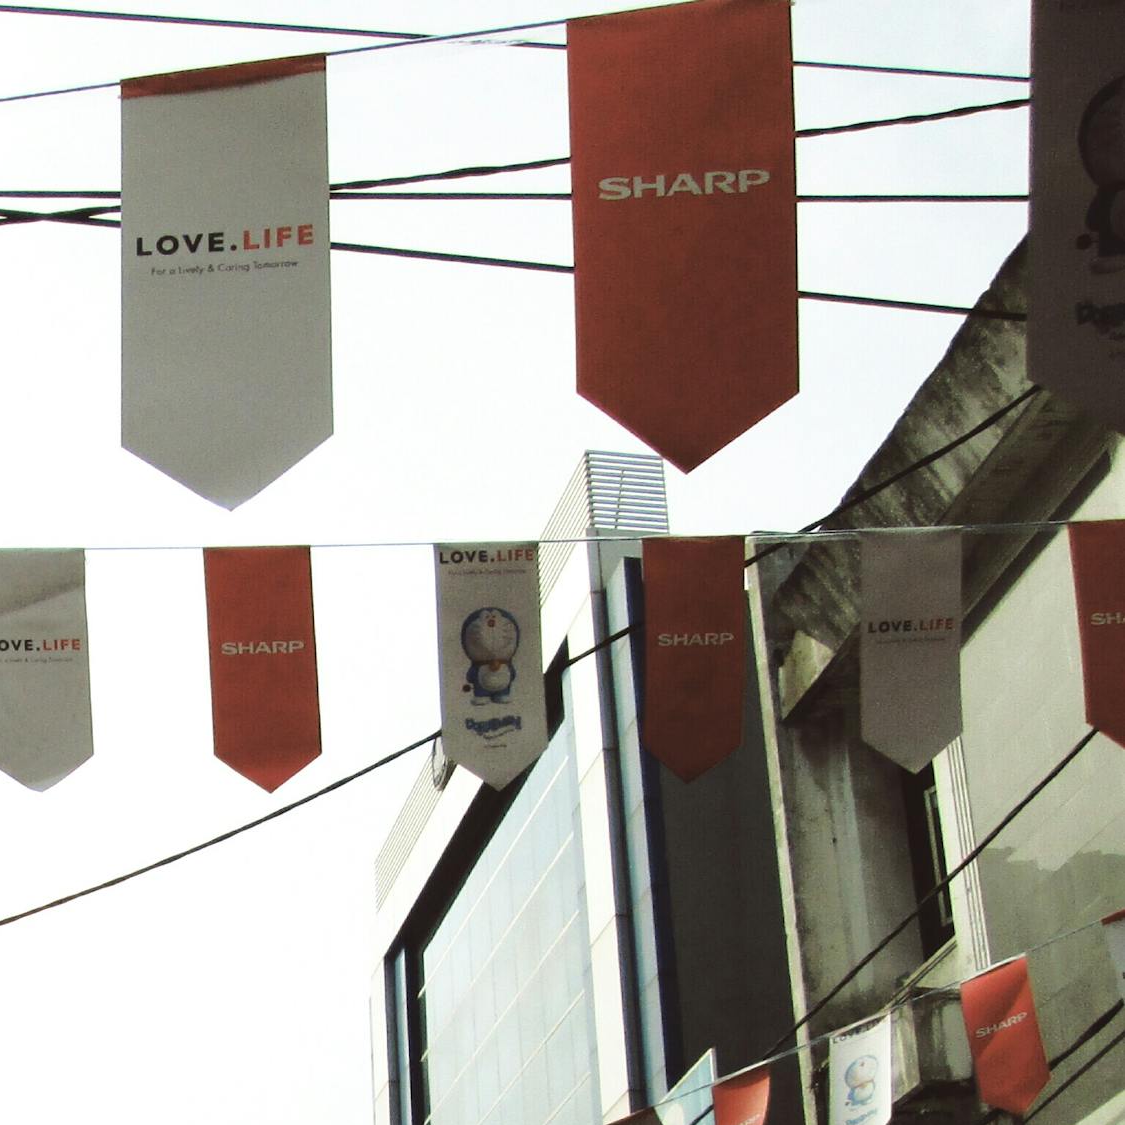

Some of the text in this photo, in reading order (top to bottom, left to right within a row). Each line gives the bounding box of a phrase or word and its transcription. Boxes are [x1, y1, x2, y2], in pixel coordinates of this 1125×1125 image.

[598, 169, 770, 201] SHARP
[136, 224, 313, 256] LOVE.LIFE
[151, 267, 165, 276] For
[178, 265, 204, 275] Lively
[217, 262, 249, 273] Caring
[253, 260, 299, 269] Tomorrow
[439, 549, 534, 564] LOVE.LIFE
[867, 617, 955, 633] LOVE.LIFE
[221, 640, 304, 656] SHARP
[657, 633, 734, 648] SHARP
[975, 1012, 1028, 1038] SHARP
